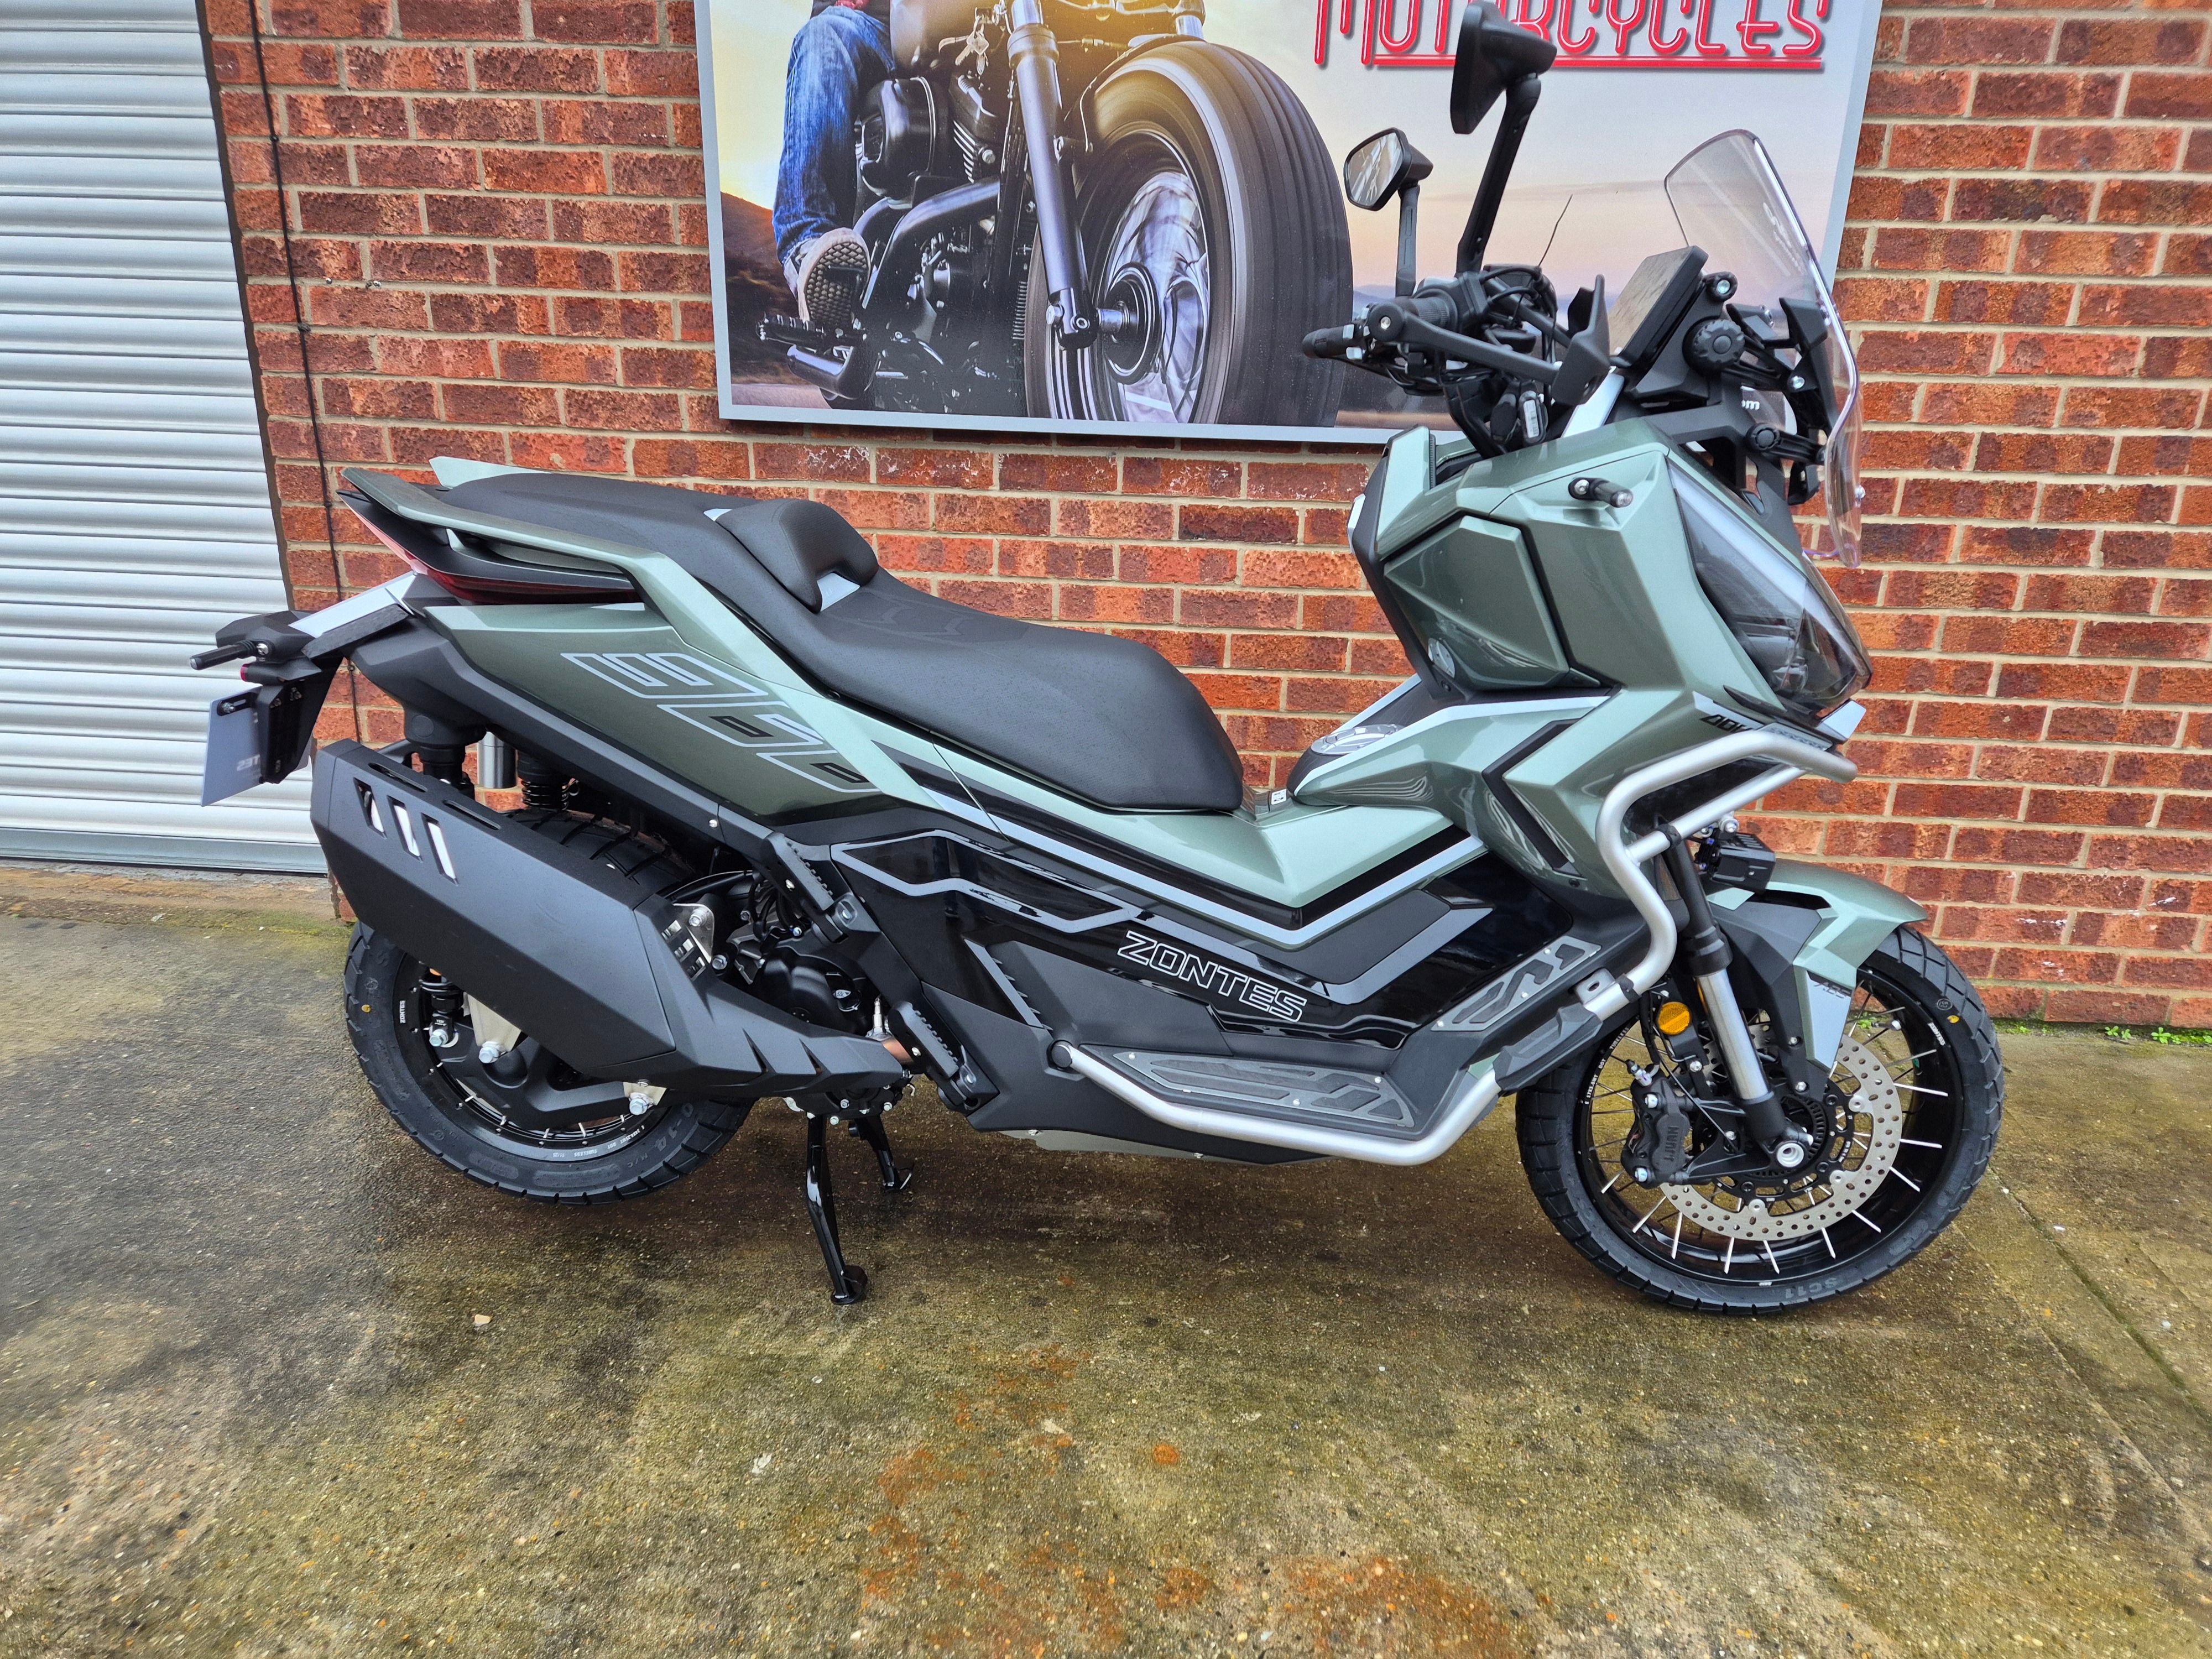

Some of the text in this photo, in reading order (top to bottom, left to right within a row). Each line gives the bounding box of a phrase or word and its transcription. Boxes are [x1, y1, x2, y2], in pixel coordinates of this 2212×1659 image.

[1117, 930, 1307, 1023] ZONTES
[1927, 1022, 1946, 1046] ZONTES
[1786, 1277, 1839, 1299] SC11
